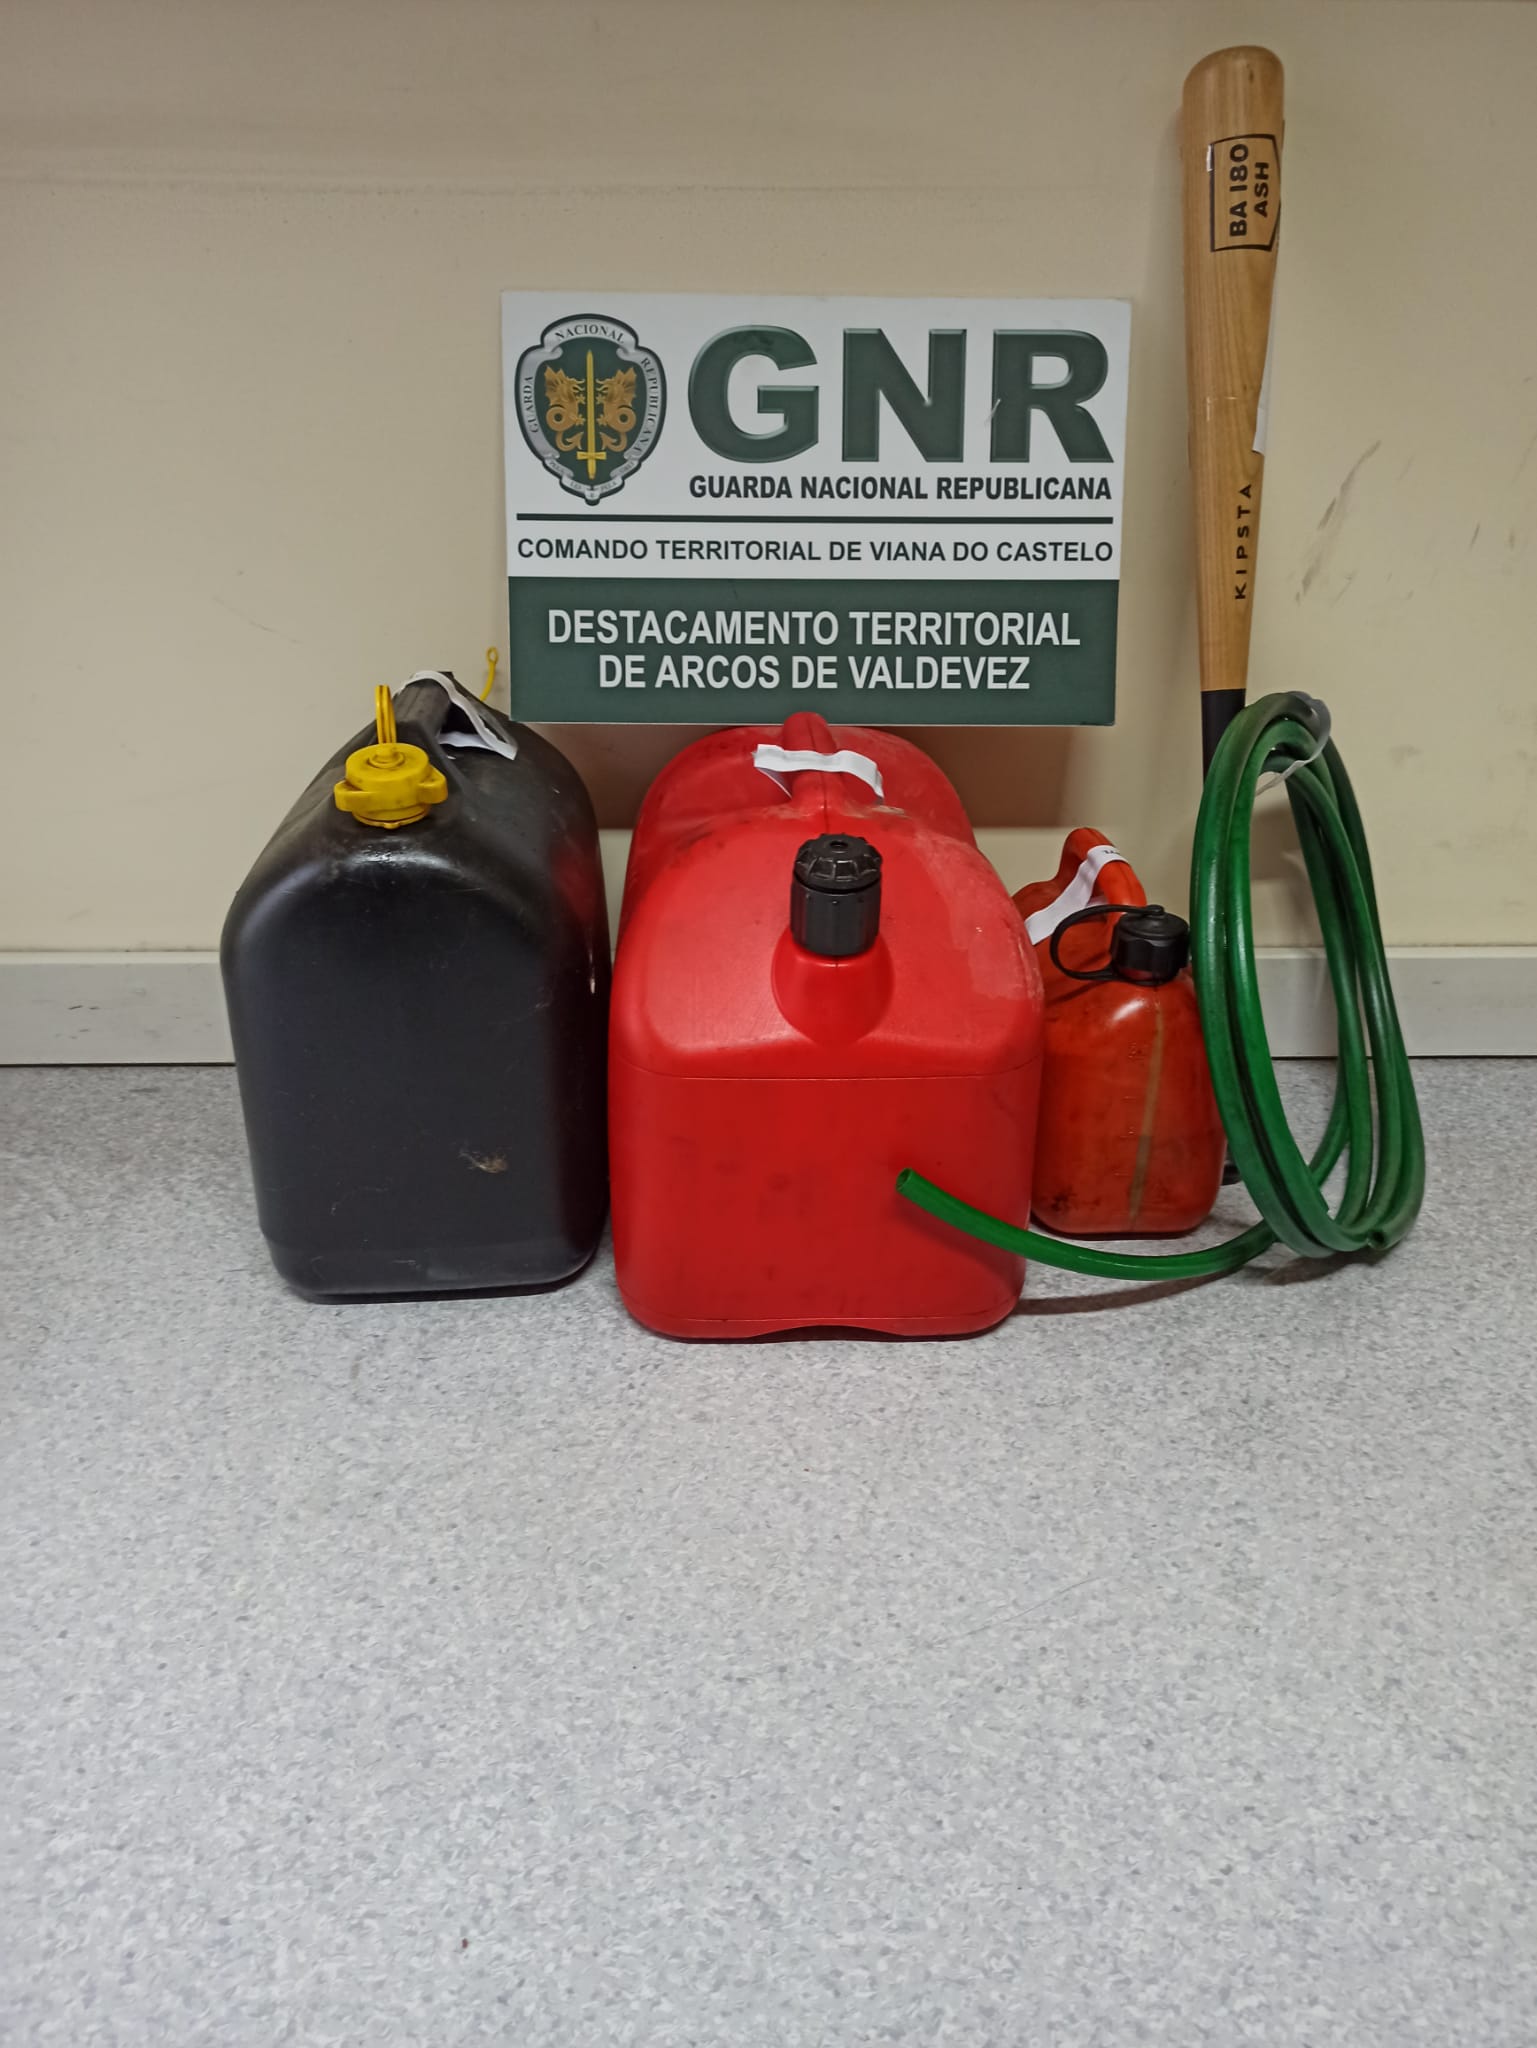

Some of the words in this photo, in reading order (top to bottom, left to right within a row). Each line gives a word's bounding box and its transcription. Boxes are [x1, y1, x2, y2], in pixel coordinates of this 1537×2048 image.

[1254, 162, 1269, 218] ASH
[1229, 200, 1247, 237] BA
[555, 324, 625, 344] NACIONAL
[523, 376, 540, 433] GUARDA
[633, 357, 660, 453] REPUBLICANA
[688, 325, 1114, 463] GNR
[689, 475, 793, 499] GUARDA
[801, 476, 928, 500] NACIONAL
[937, 477, 1112, 500] REPUBLICANA
[518, 538, 648, 559] COMANDO
[656, 540, 821, 560] TERRITORIAL
[829, 541, 862, 561] DE
[870, 541, 946, 561] VIANA
[953, 541, 989, 561] DO
[996, 541, 1113, 562] CASTELO
[1235, 484, 1252, 600] KIPSTA
[548, 610, 839, 645] DESTACAMENTO
[849, 611, 1081, 646] TERRITORIAL
[600, 655, 645, 688] DE
[655, 655, 780, 689] ARCOS
[792, 655, 838, 689] DE
[848, 656, 1030, 689] VALDEVEZ
